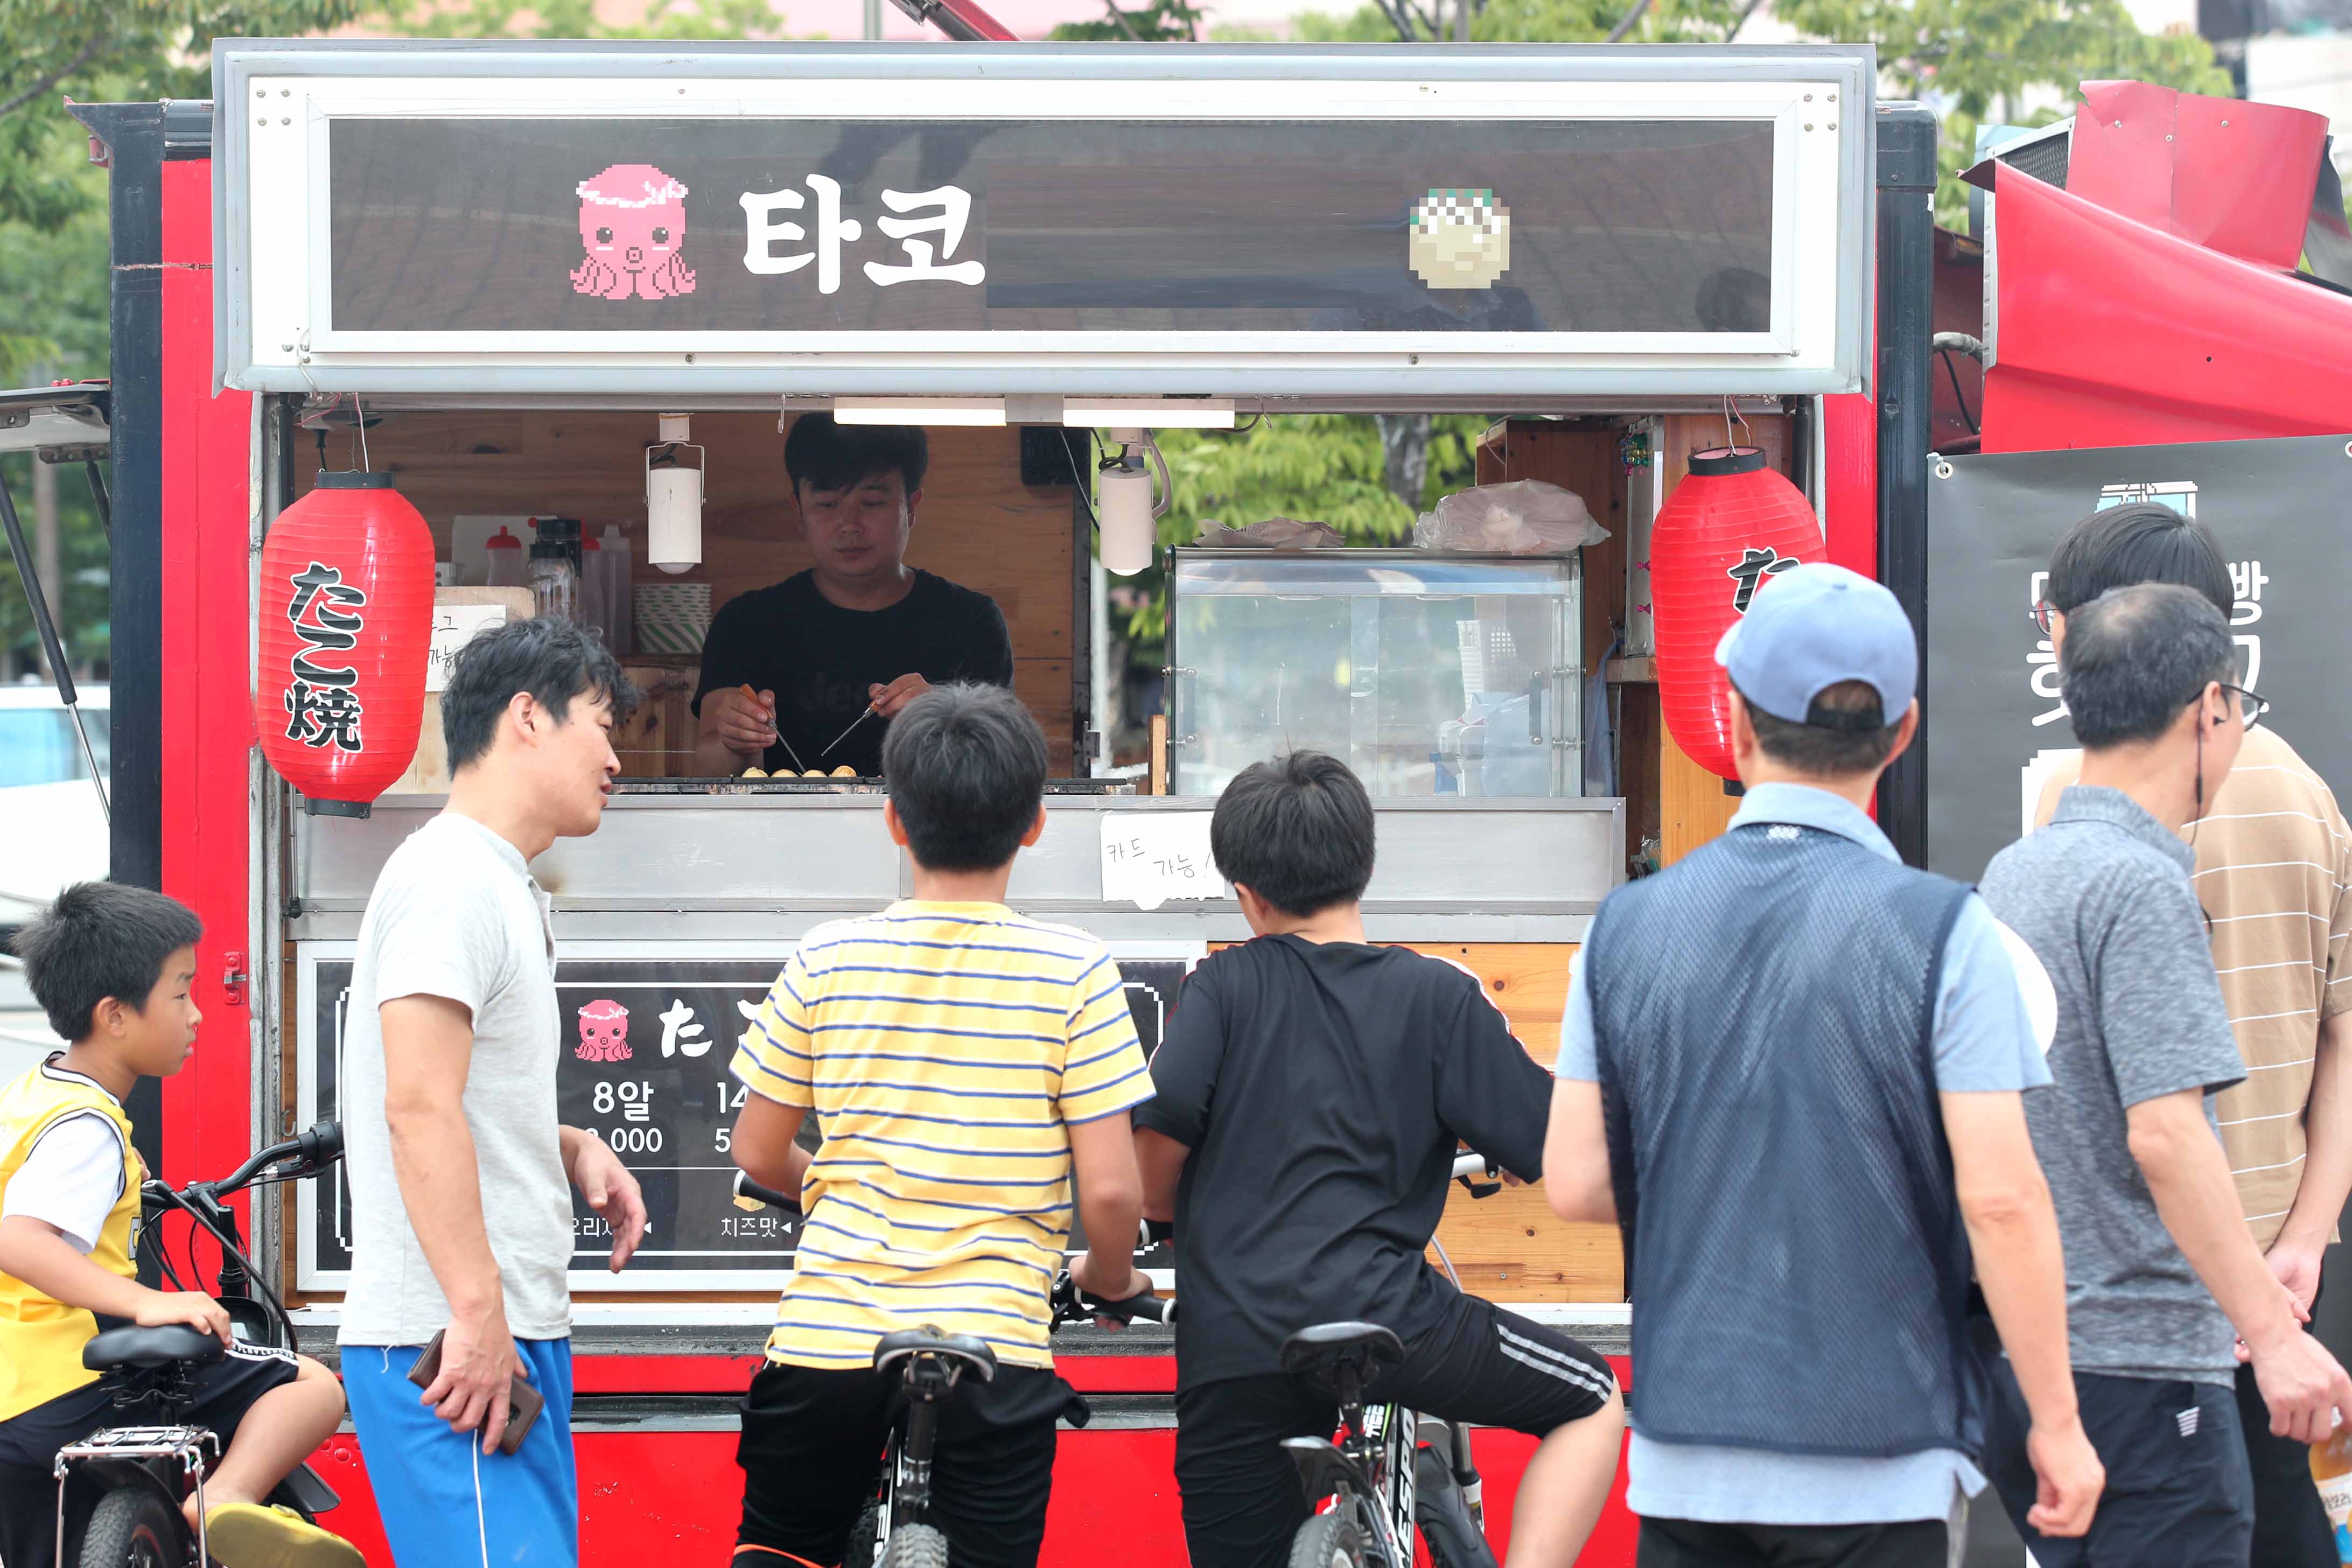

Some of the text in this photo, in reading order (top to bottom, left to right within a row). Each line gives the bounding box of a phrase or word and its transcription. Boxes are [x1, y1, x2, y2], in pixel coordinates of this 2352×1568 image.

[739, 174, 985, 293] 타코
[432, 616, 458, 632] 그
[284, 561, 367, 753] たこ焼
[1107, 838, 1145, 863] 카드
[593, 1082, 654, 1121] 8알
[716, 1082, 749, 1114] 14
[722, 1217, 778, 1237] 치즈맛
